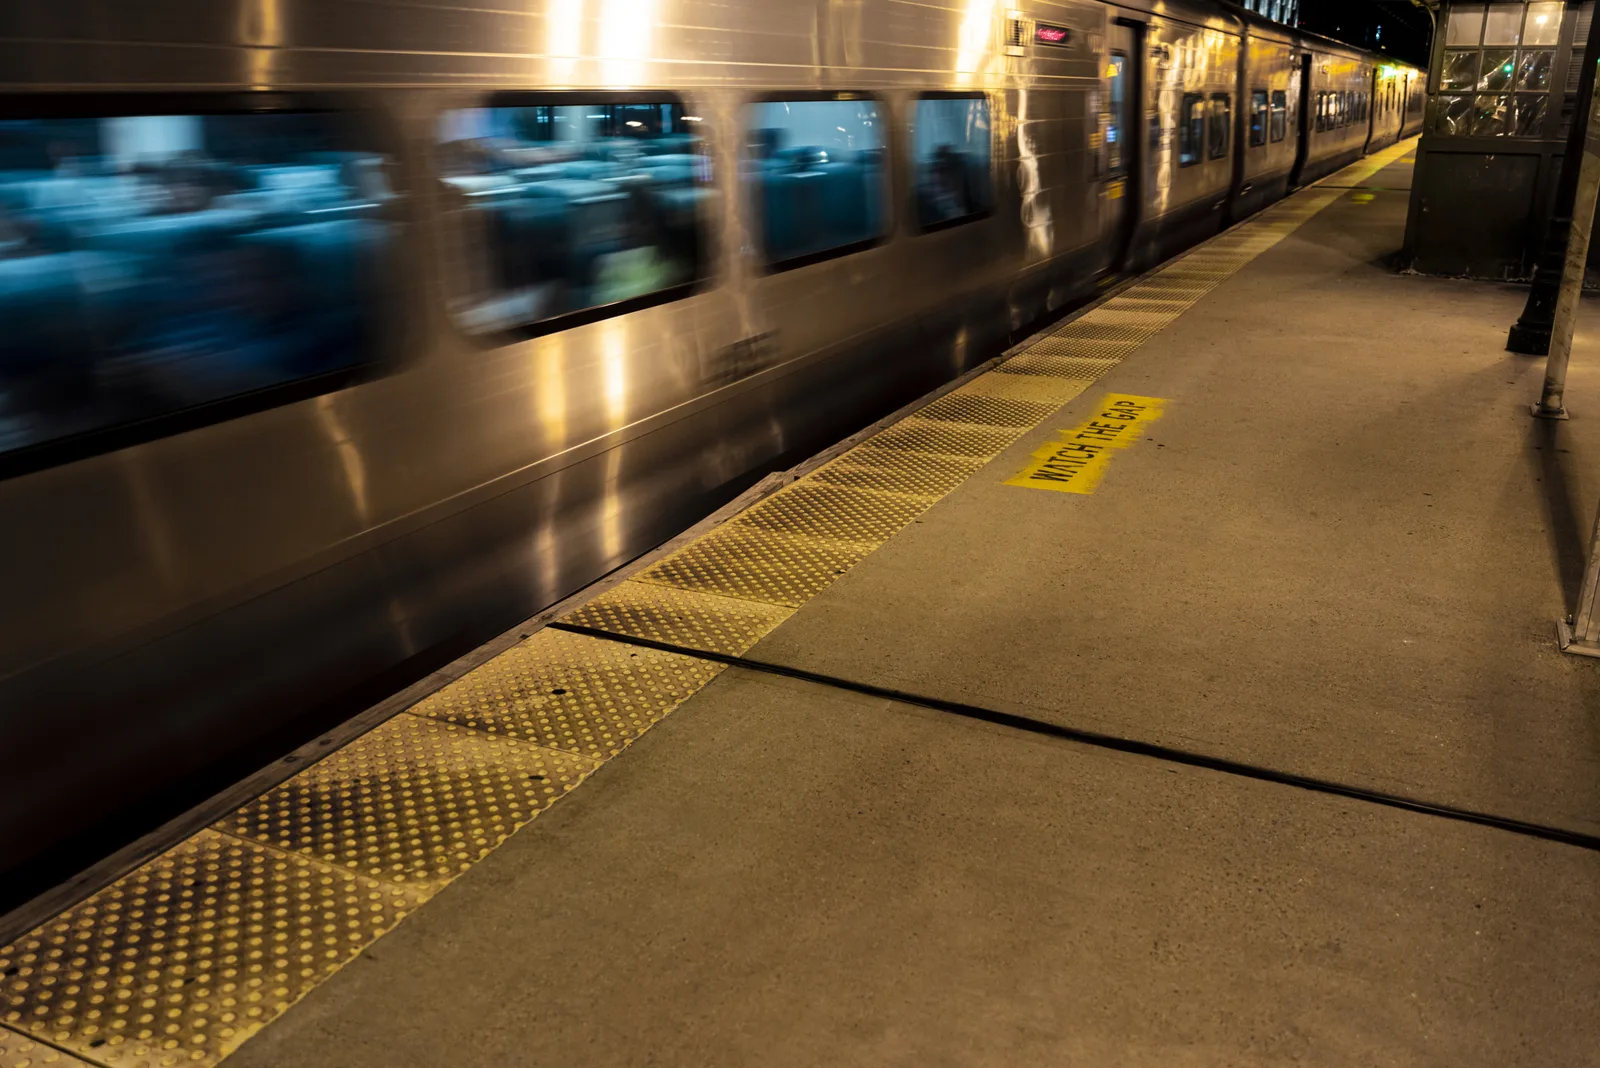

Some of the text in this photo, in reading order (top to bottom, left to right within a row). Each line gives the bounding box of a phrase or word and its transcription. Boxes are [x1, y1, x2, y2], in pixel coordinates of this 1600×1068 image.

[1030, 400, 1147, 482] WATCH THE GAP
